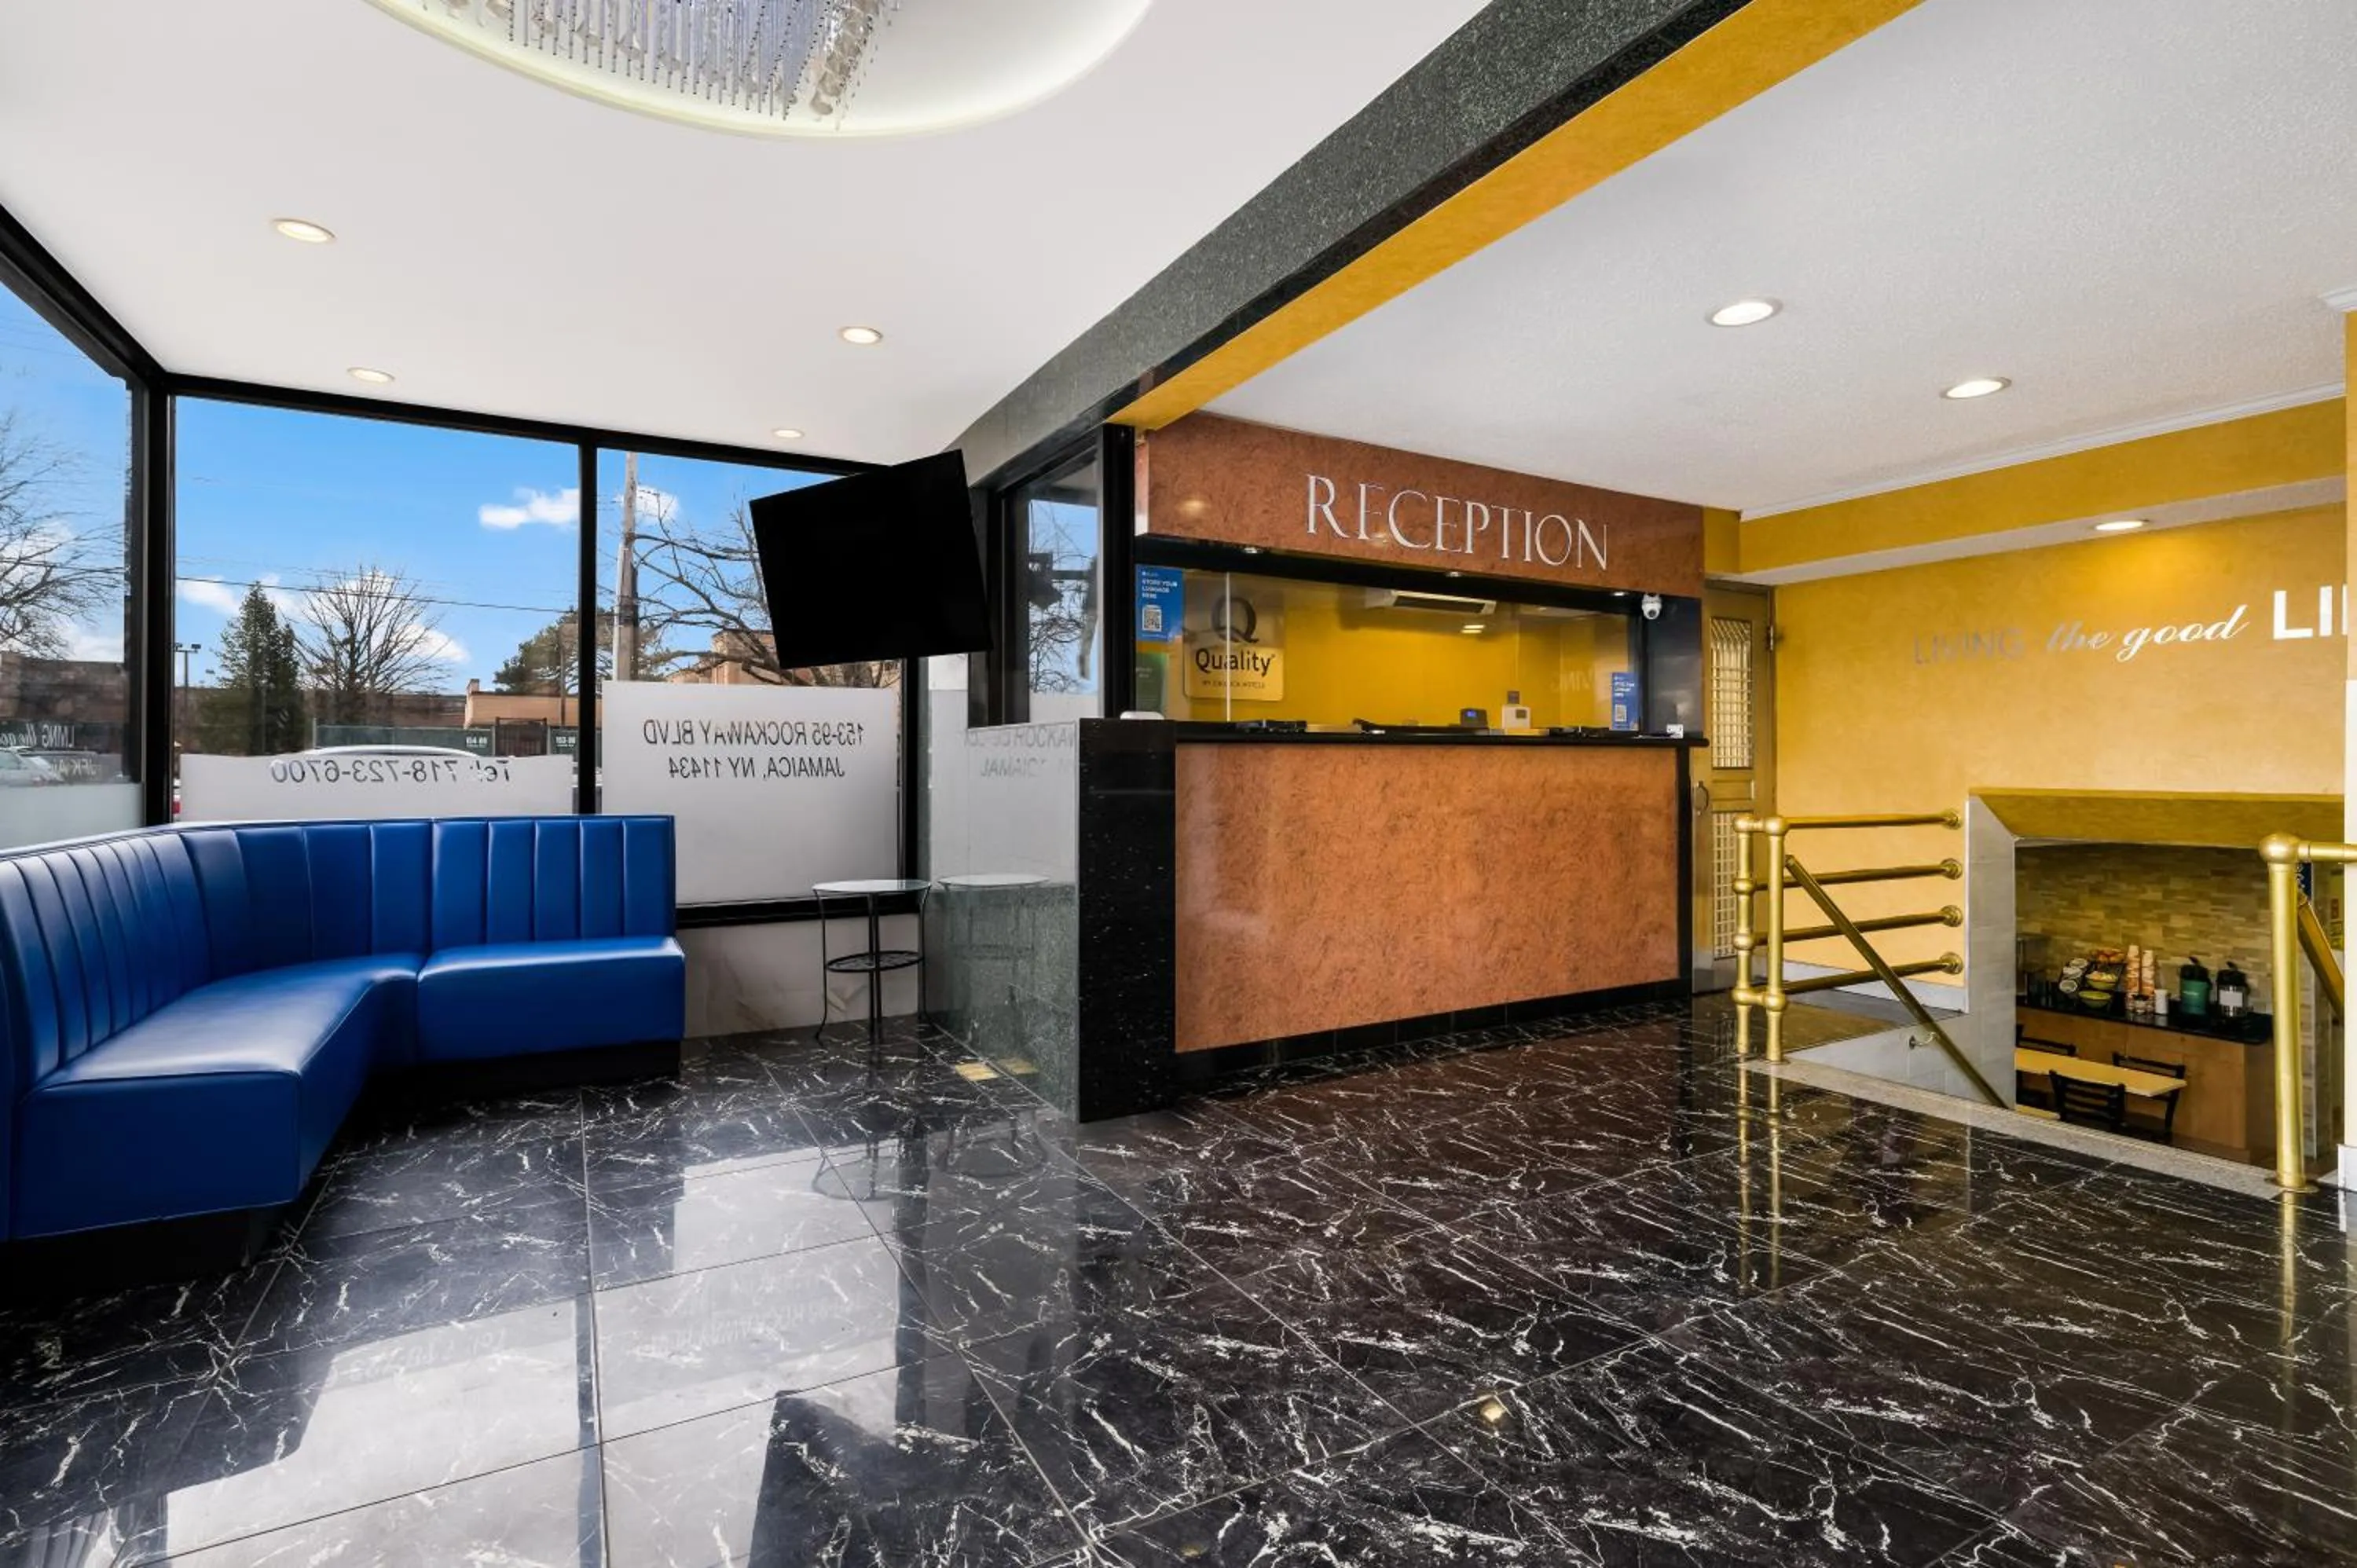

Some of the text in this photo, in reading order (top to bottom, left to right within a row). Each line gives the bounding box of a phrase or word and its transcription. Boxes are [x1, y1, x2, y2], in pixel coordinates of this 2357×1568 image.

[1307, 474, 1608, 571] RECEPTION
[1211, 595, 1259, 643] Q
[1914, 627, 2026, 665] LIVING
[2046, 621, 2114, 652] the
[2116, 604, 2250, 662] good
[1195, 647, 1272, 677] Quality
